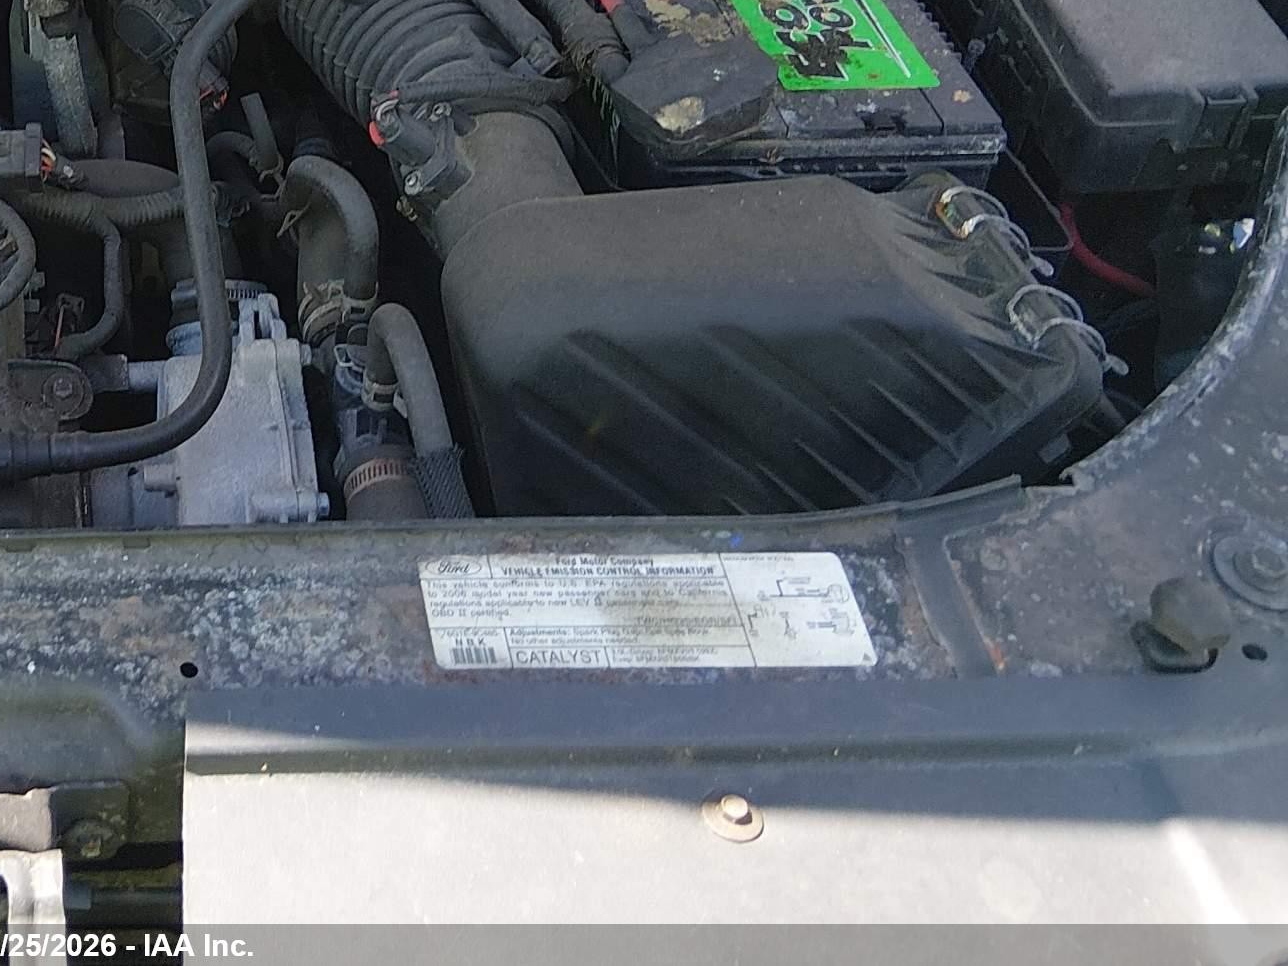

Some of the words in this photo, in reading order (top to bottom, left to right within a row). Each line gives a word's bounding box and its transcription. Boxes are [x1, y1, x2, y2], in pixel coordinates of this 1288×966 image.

[437, 560, 471, 574] Ford
[555, 557, 577, 566] Ford
[579, 557, 608, 566] Motor
[609, 557, 655, 567] Company
[501, 566, 543, 577] VEHICLE
[545, 566, 593, 576] EMISSION
[596, 566, 643, 576] CONTROL
[645, 566, 715, 576] INFORMATION
[515, 649, 602, 664] CATALYST
